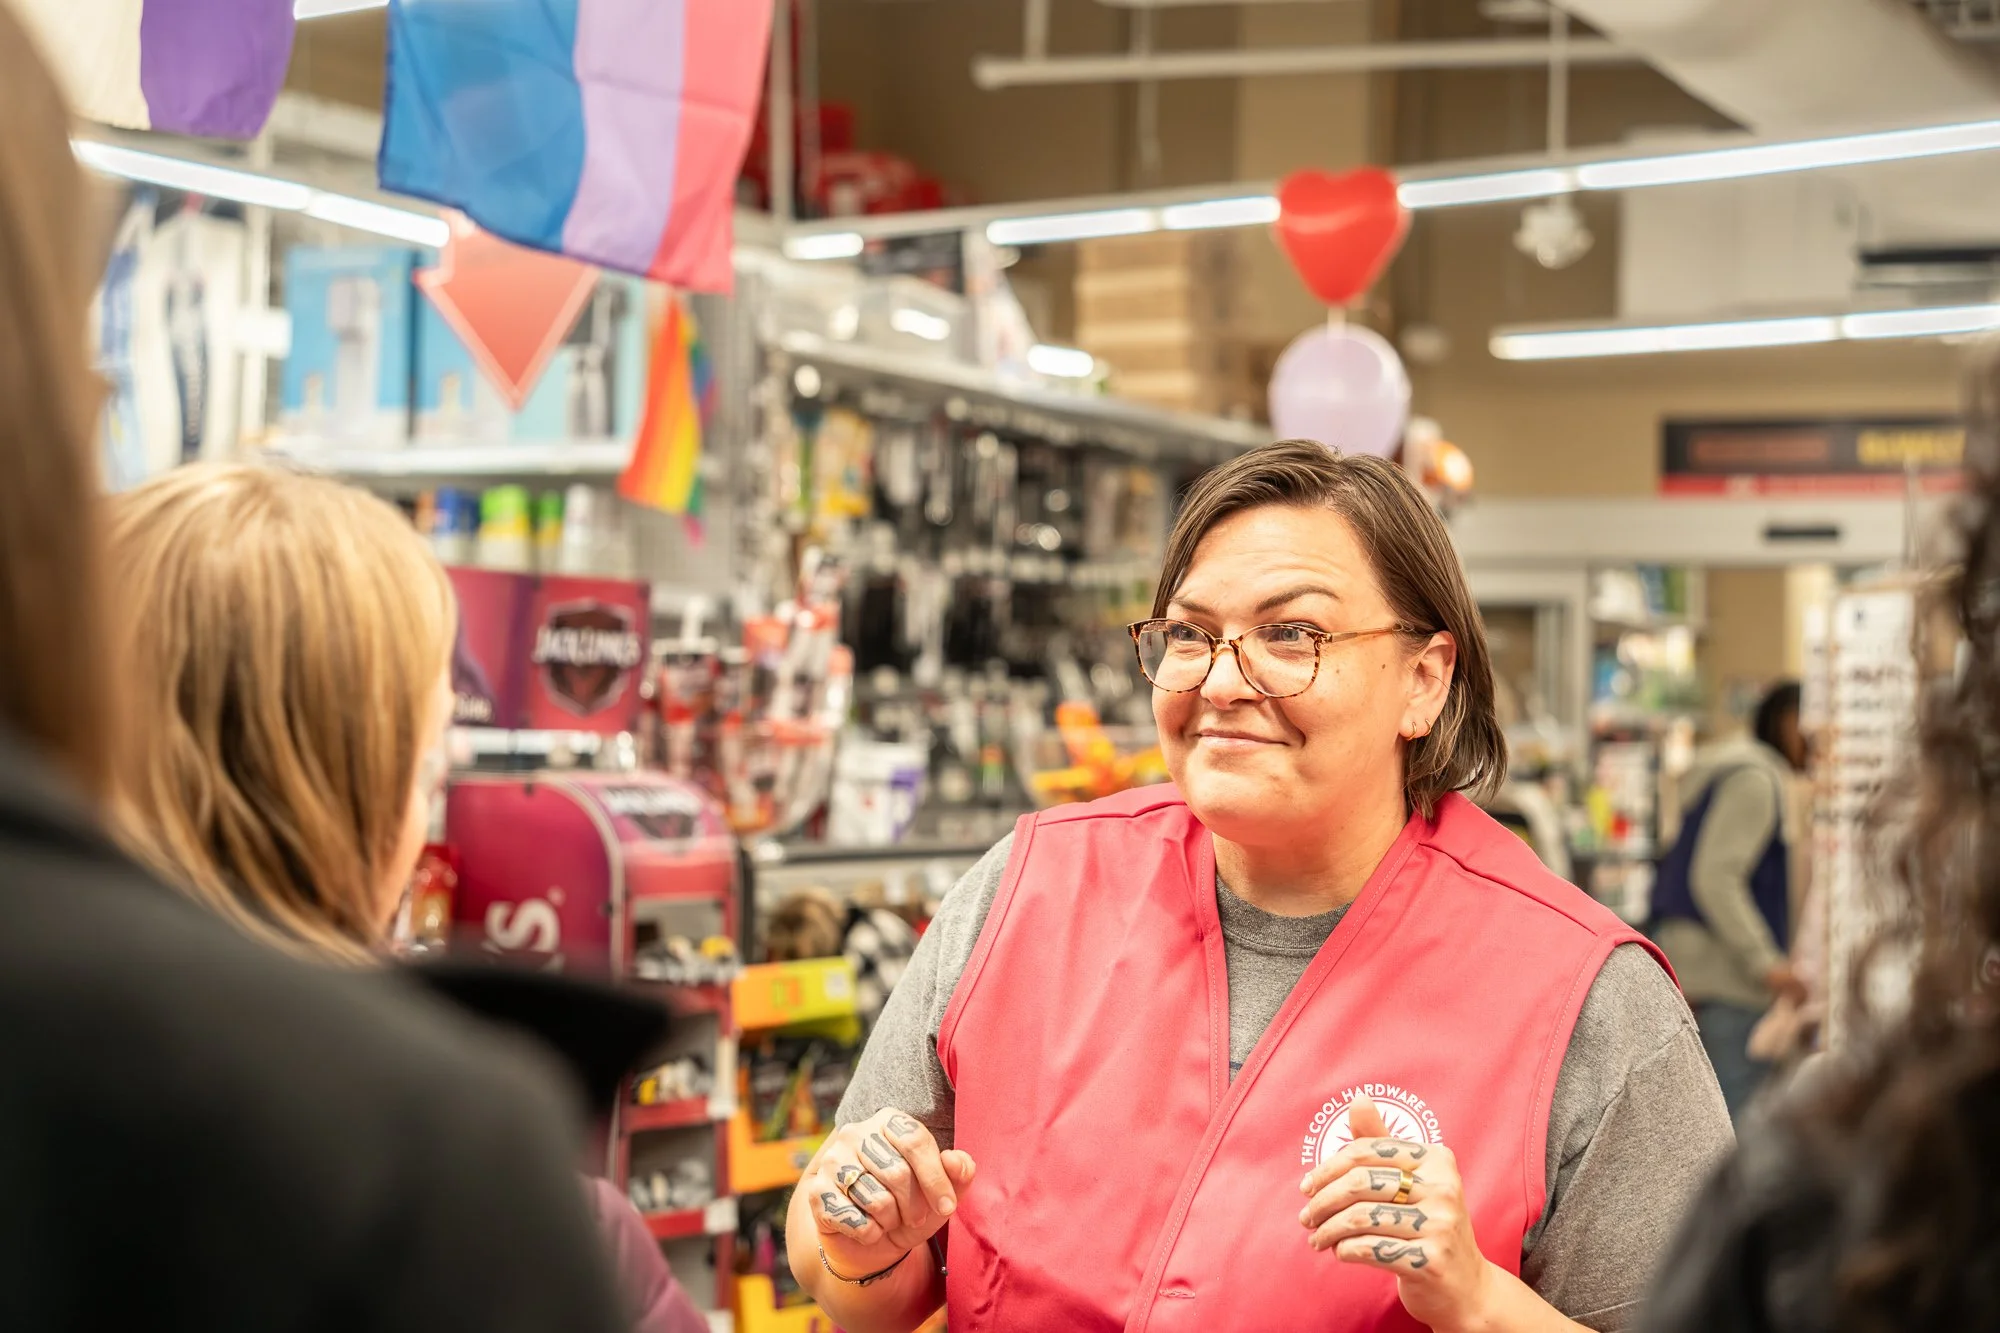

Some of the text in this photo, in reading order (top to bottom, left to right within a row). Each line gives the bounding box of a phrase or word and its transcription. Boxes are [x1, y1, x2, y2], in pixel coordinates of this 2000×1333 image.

[1301, 1083, 1444, 1165] THE COOL HARDWARE COM
